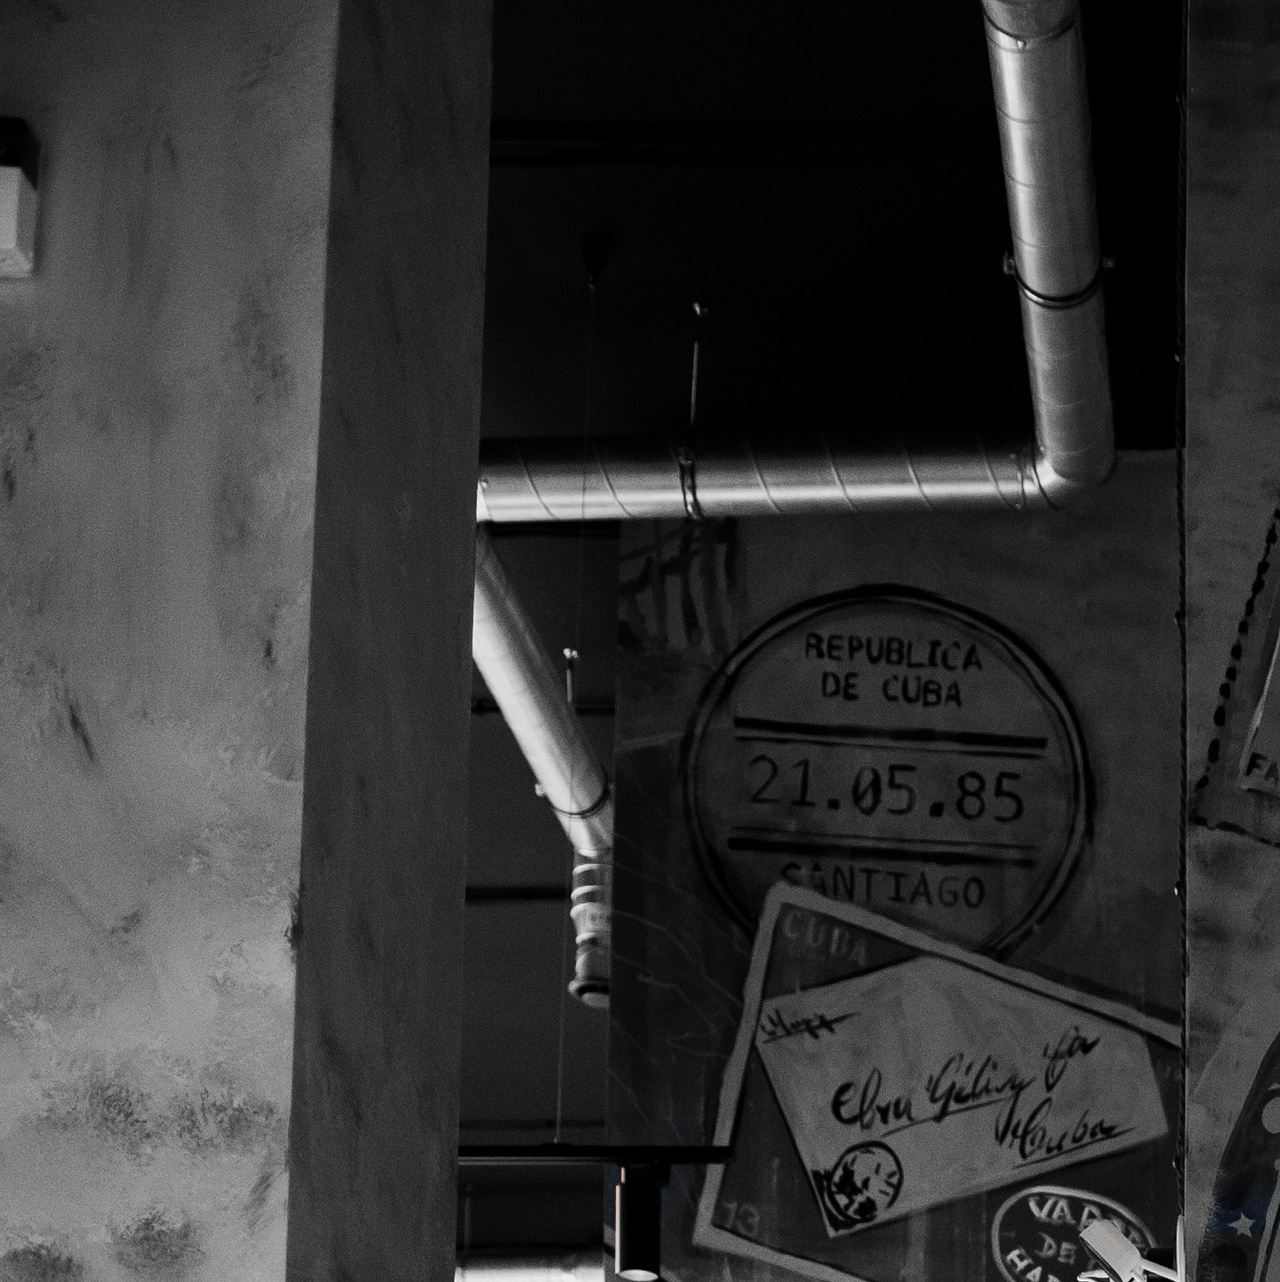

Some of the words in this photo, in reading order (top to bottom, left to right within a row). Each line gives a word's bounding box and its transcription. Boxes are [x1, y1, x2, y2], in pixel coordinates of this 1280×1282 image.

[805, 632, 984, 672] REPUBLICA
[822, 671, 859, 699] DE
[882, 674, 963, 707] CUBA
[747, 754, 1025, 822] 21.05.85
[781, 862, 986, 908] SANTIAGO
[1035, 1231, 1076, 1265] DE
